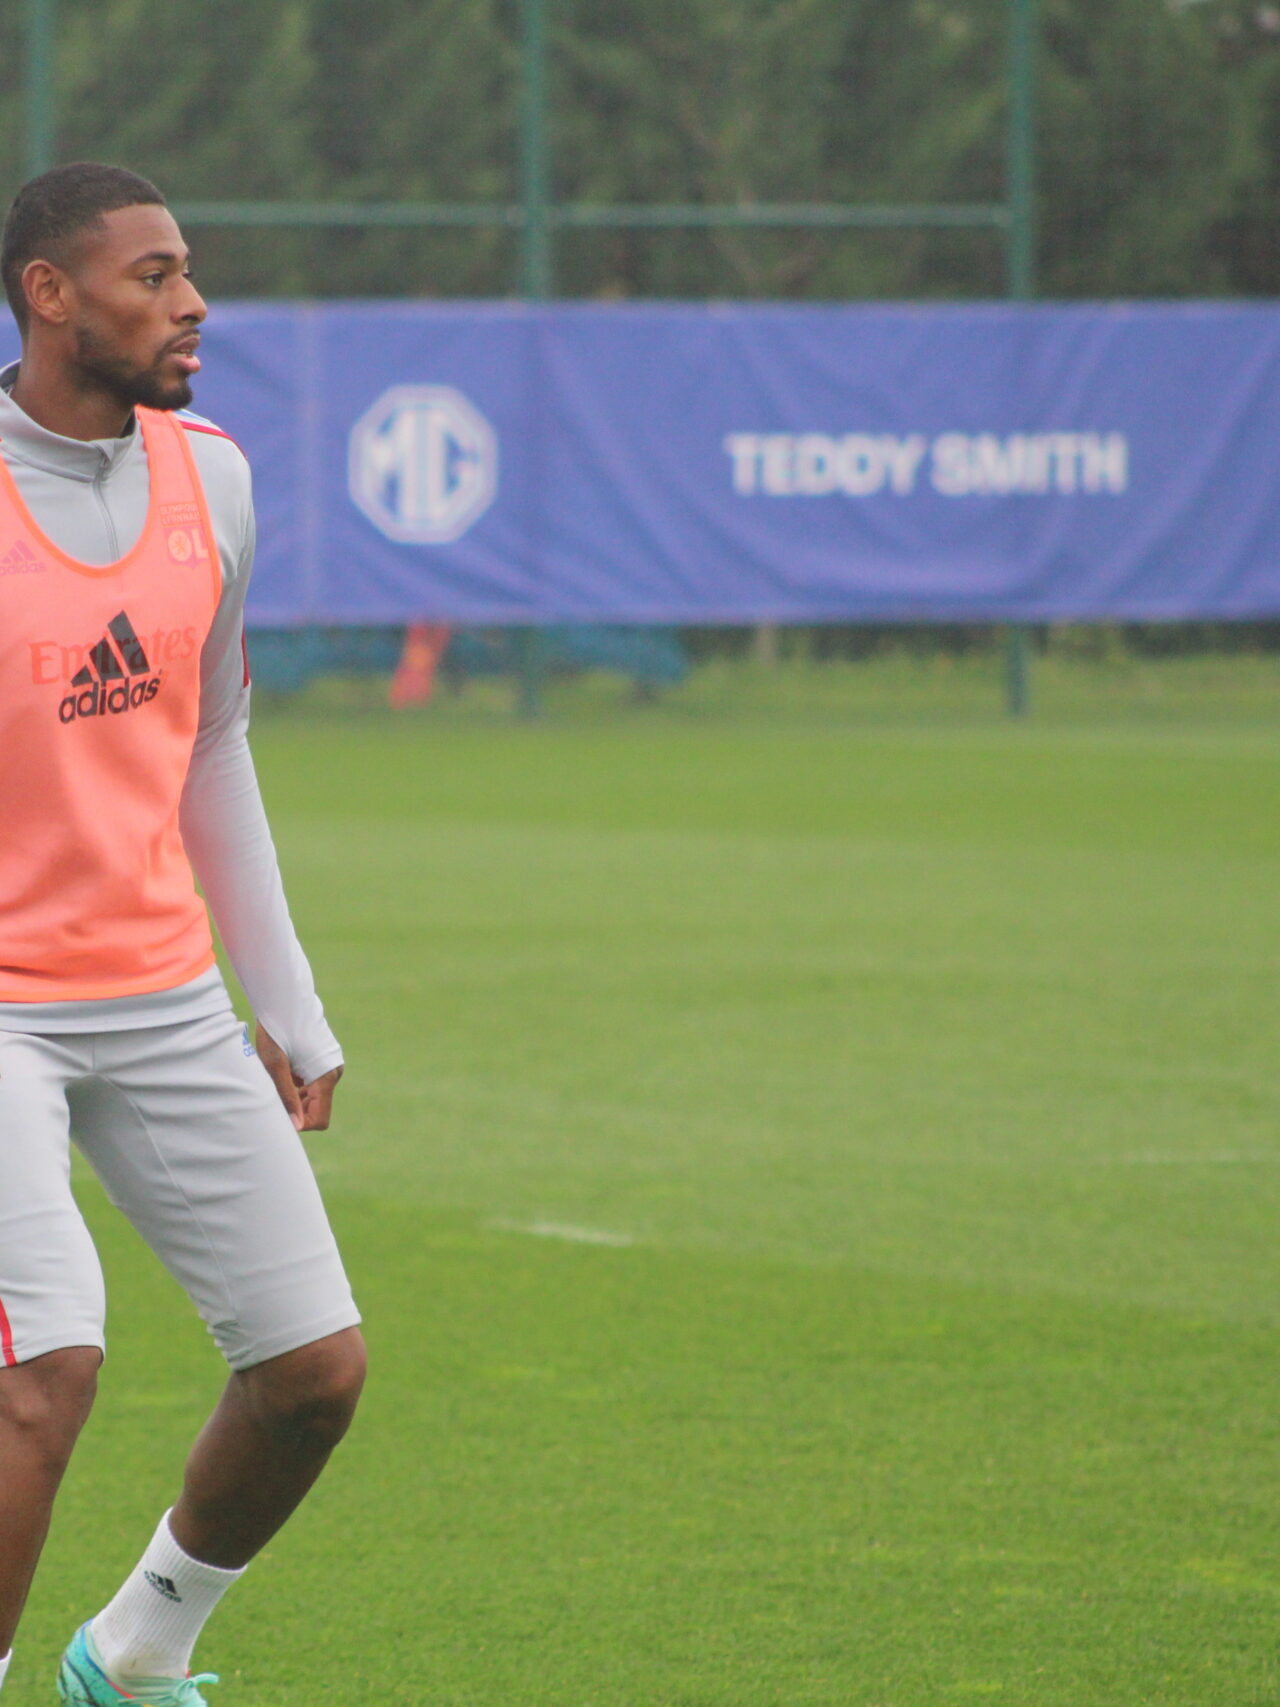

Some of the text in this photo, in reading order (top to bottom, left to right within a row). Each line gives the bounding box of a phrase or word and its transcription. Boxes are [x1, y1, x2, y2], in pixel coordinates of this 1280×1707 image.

[358, 402, 483, 525] MG
[724, 432, 1129, 498] TEDDY SMITH
[167, 529, 209, 563] OL
[58, 676, 160, 725] adidas
